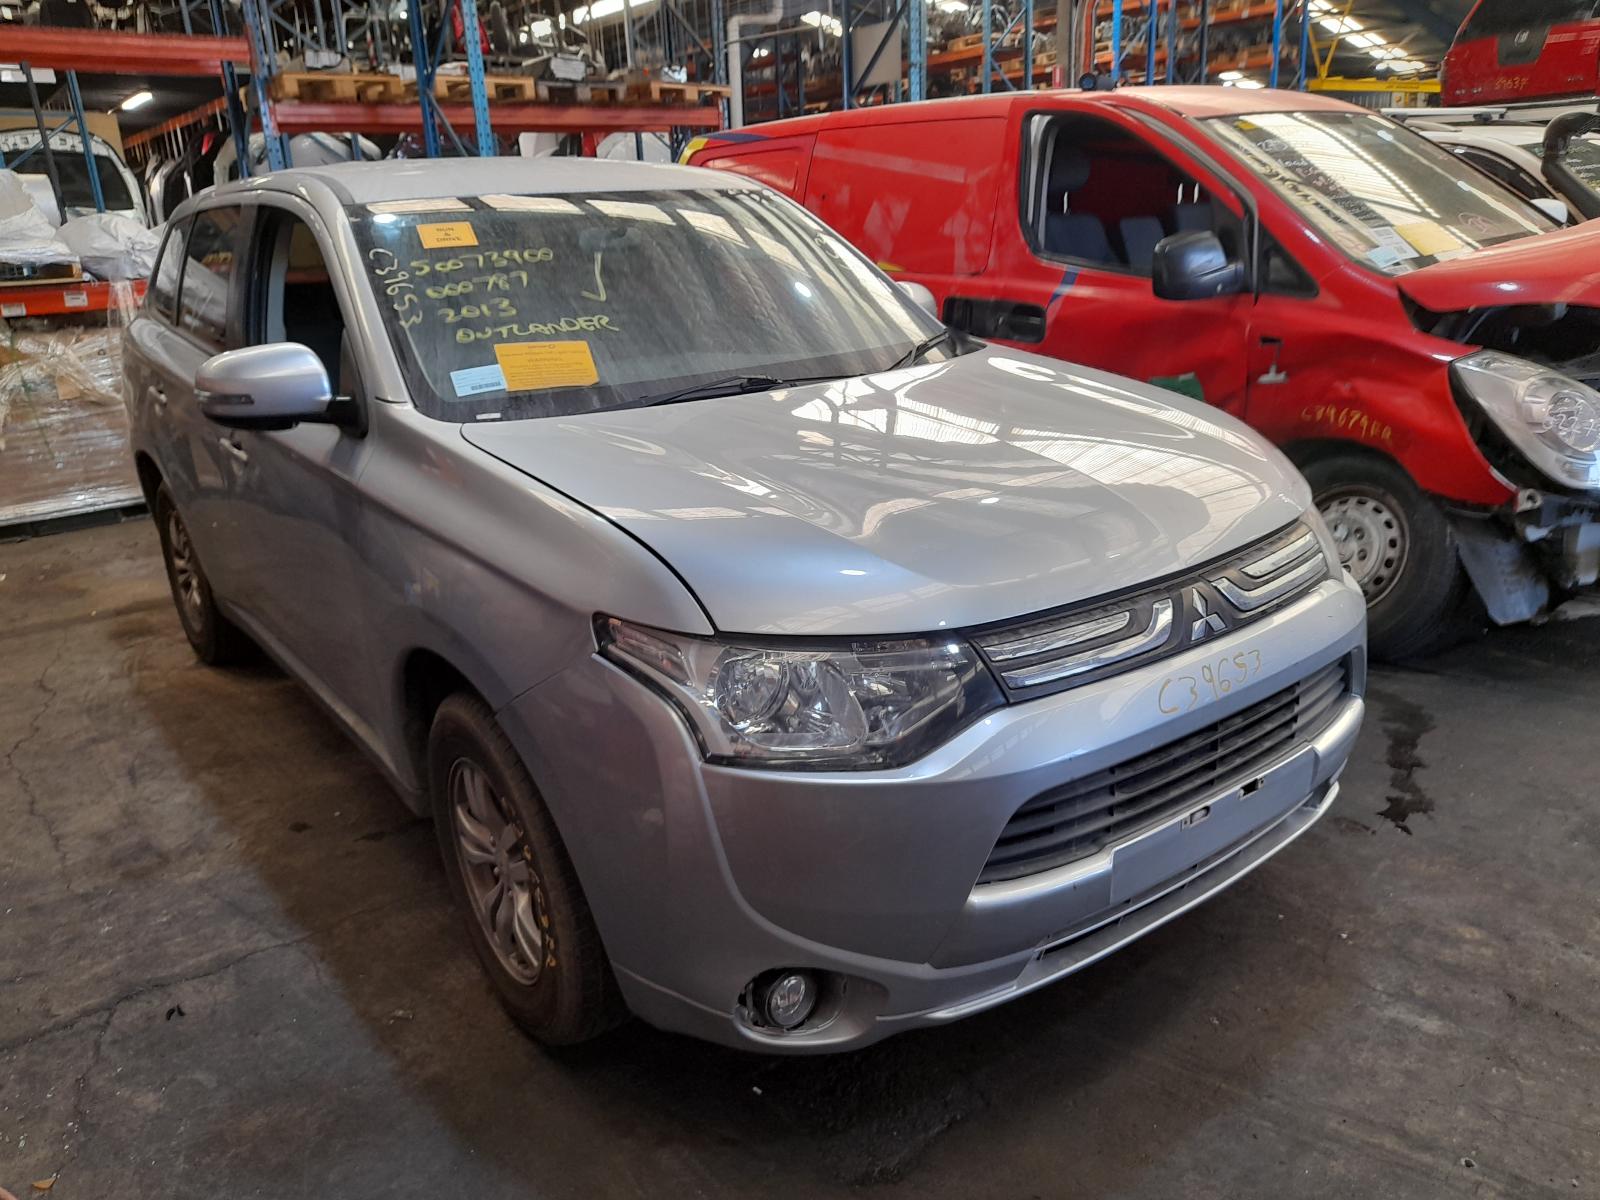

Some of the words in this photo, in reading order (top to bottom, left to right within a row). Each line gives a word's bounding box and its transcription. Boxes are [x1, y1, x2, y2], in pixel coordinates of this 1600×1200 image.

[438, 297, 517, 324] 2013
[455, 314, 619, 344] OUTLANDER
[1158, 649, 1261, 714] C39653
